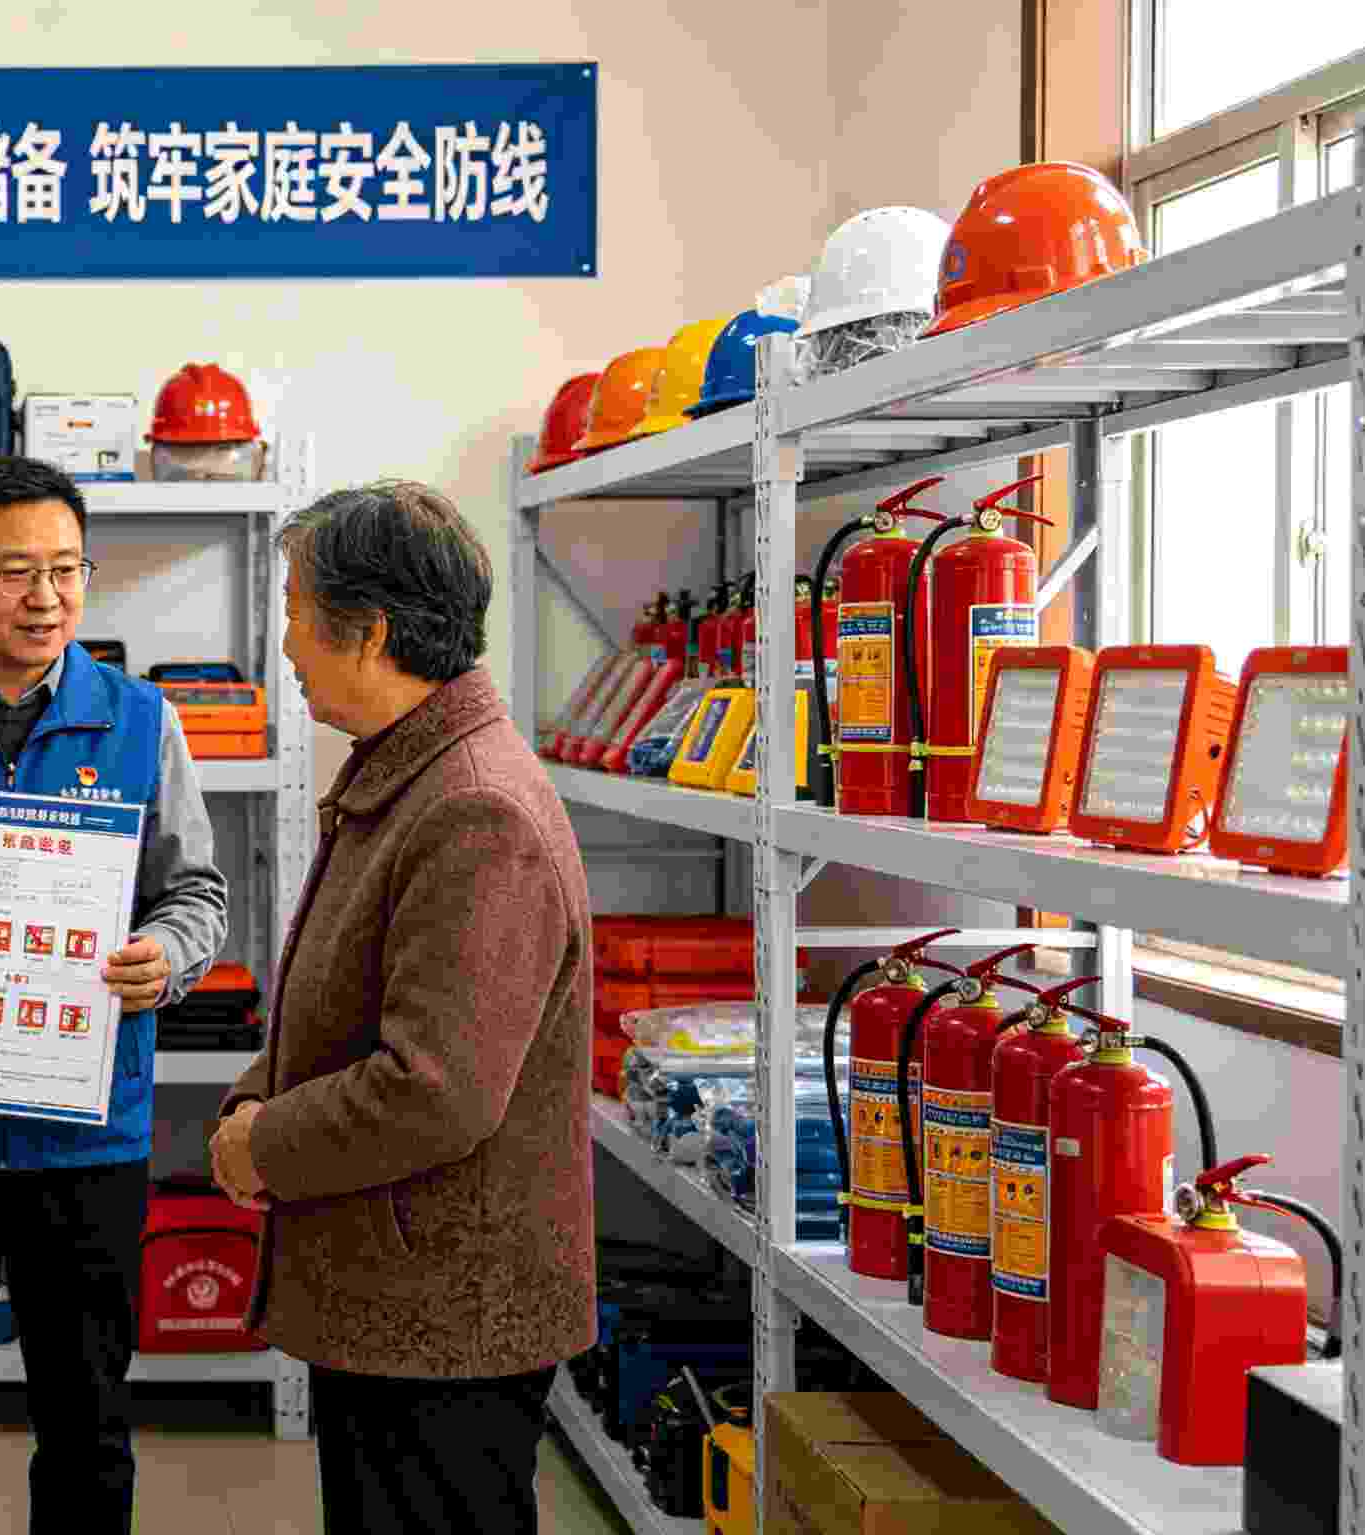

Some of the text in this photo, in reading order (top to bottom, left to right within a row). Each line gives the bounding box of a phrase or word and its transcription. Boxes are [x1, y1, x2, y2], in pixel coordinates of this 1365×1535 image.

[89, 120, 549, 224] 筑牢家庭安全防线
